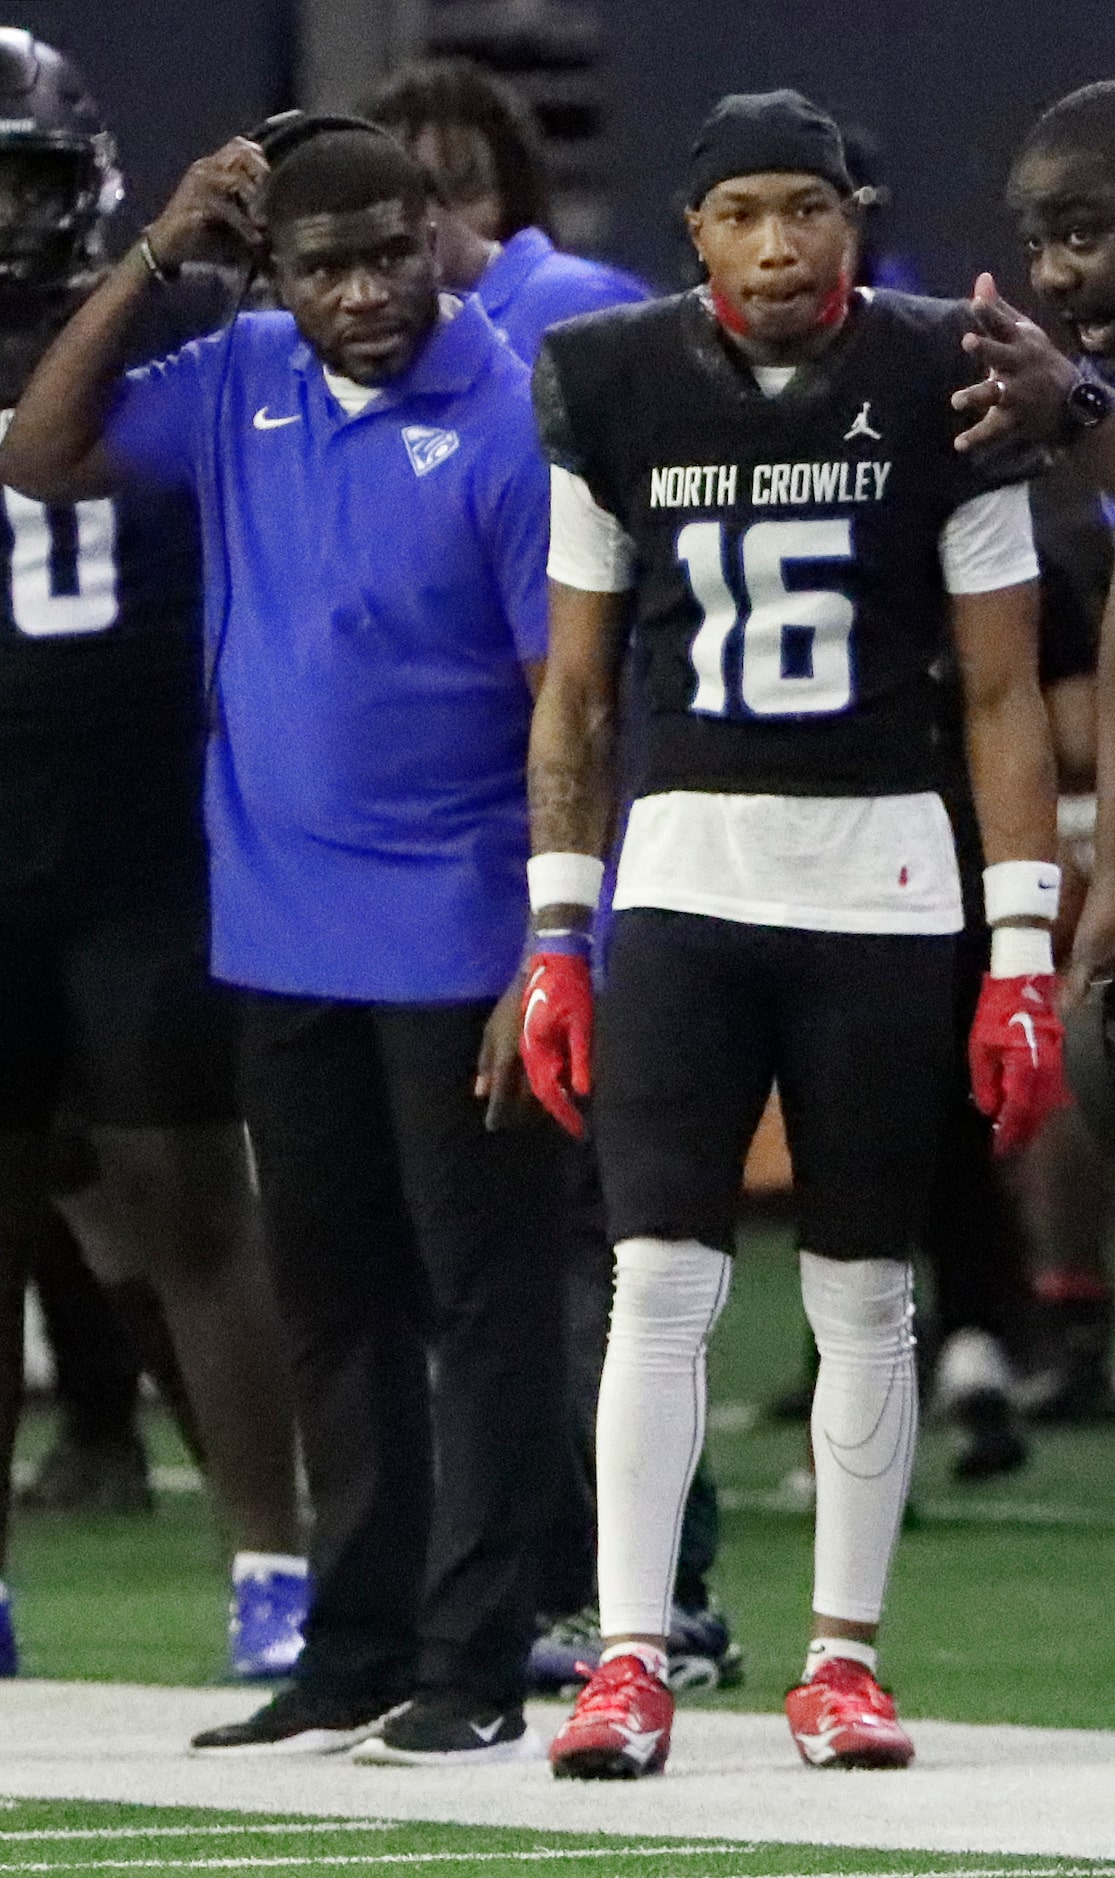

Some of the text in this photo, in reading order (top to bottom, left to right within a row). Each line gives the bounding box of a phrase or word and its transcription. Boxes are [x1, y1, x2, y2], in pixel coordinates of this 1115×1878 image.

[650, 461, 892, 508] NORTH CROWLEY
[675, 518, 856, 716] 16
